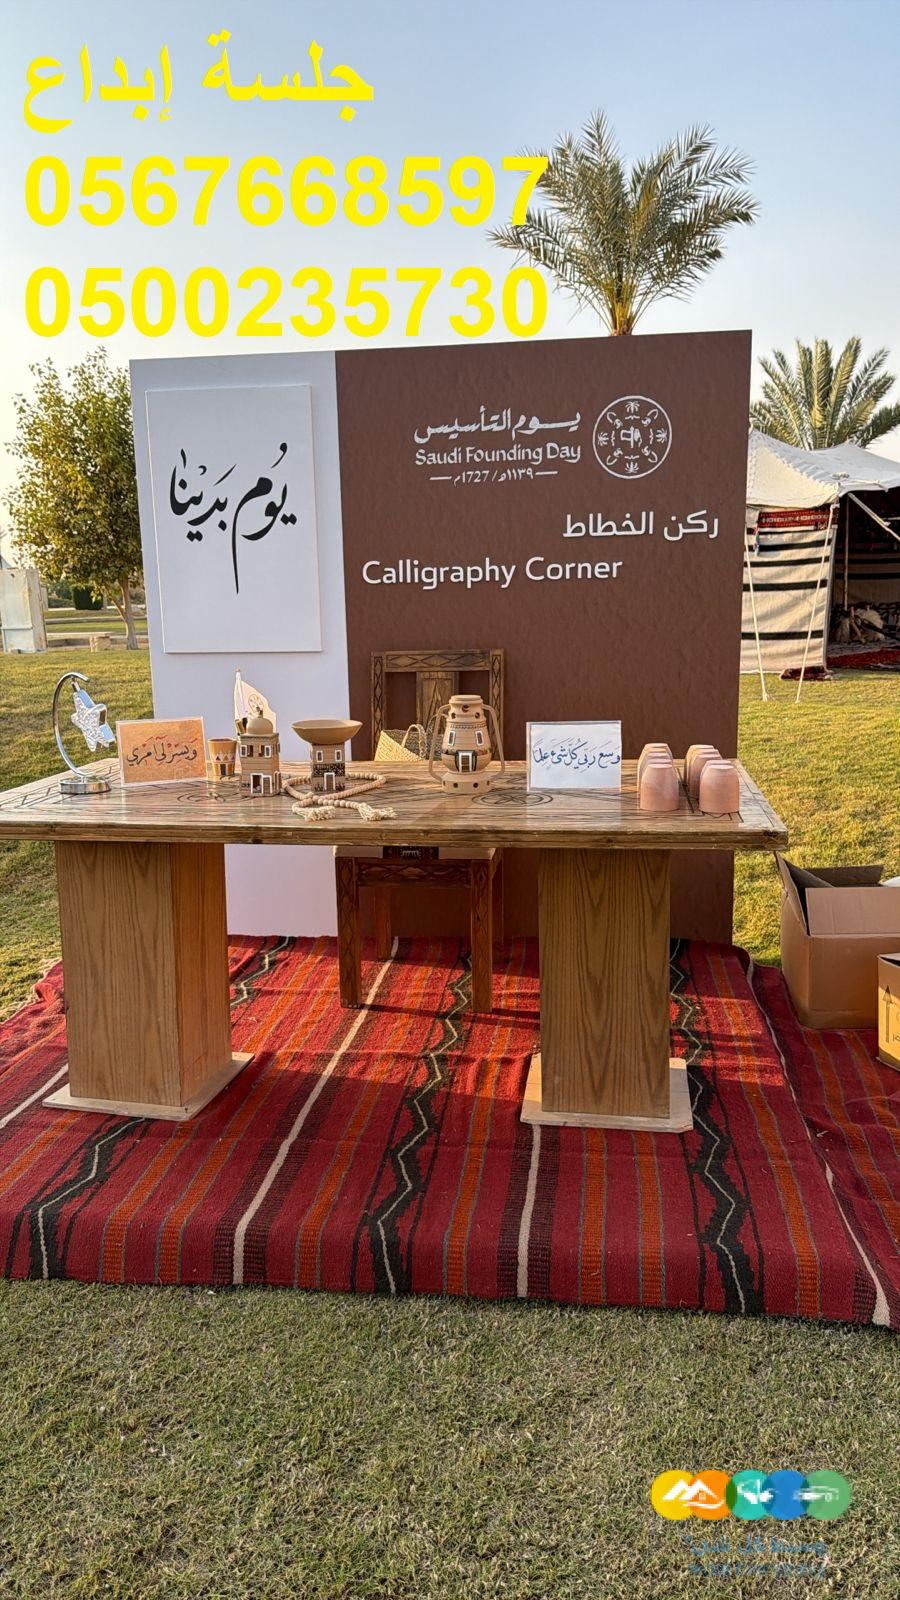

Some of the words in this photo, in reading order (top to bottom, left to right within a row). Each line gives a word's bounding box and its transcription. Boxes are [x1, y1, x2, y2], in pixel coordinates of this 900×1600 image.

[413, 405, 512, 444] التأسيس
[511, 411, 581, 441] يوم
[415, 447, 462, 466] Saudi
[466, 443, 543, 465] Founding
[546, 442, 581, 464] Day
[562, 510, 654, 538] الخطاط
[663, 509, 719, 541] ركن
[362, 556, 516, 590] Calligraphy
[525, 556, 623, 581] Corner
